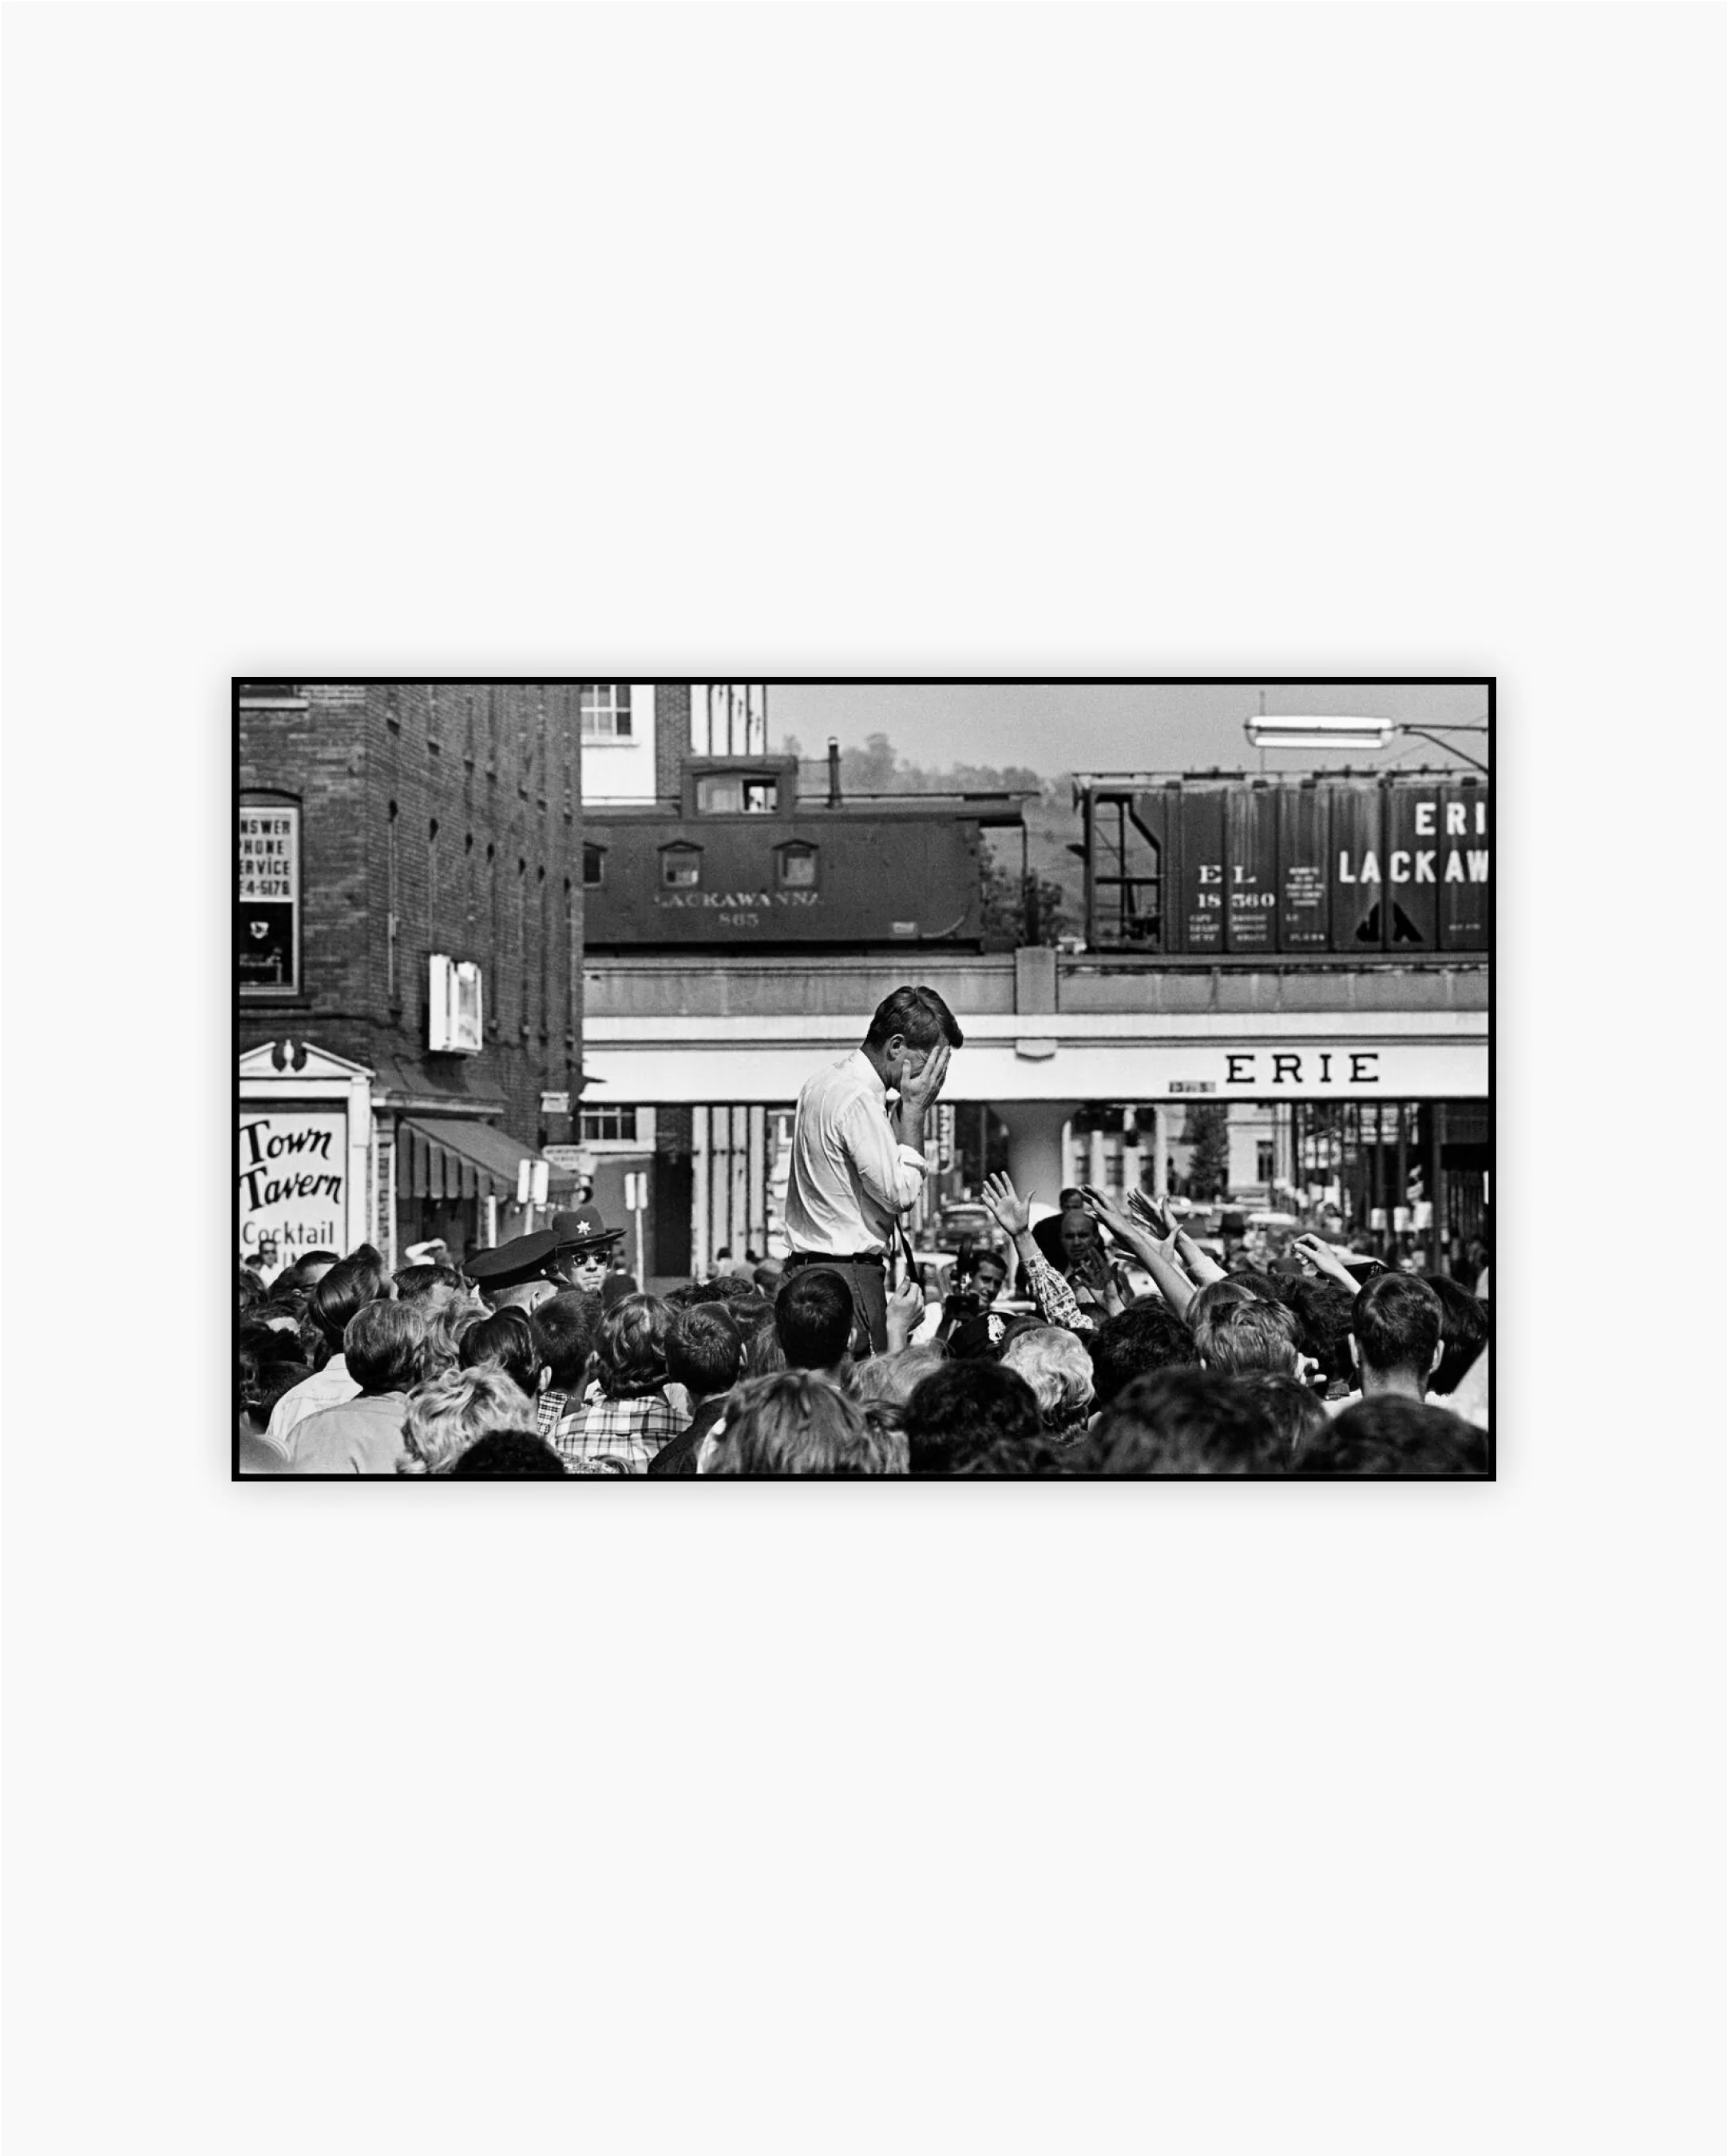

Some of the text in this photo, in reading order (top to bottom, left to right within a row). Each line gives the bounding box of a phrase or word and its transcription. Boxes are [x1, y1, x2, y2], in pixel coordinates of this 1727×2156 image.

[1416, 801, 1487, 836] ERI
[240, 841, 284, 855] HONE
[1339, 850, 1489, 884] LACKAW
[1226, 1053, 1379, 1084] ERIE
[240, 1119, 333, 1166] Town
[240, 1165, 343, 1213] Tavern
[243, 1220, 334, 1245] Cocktail
